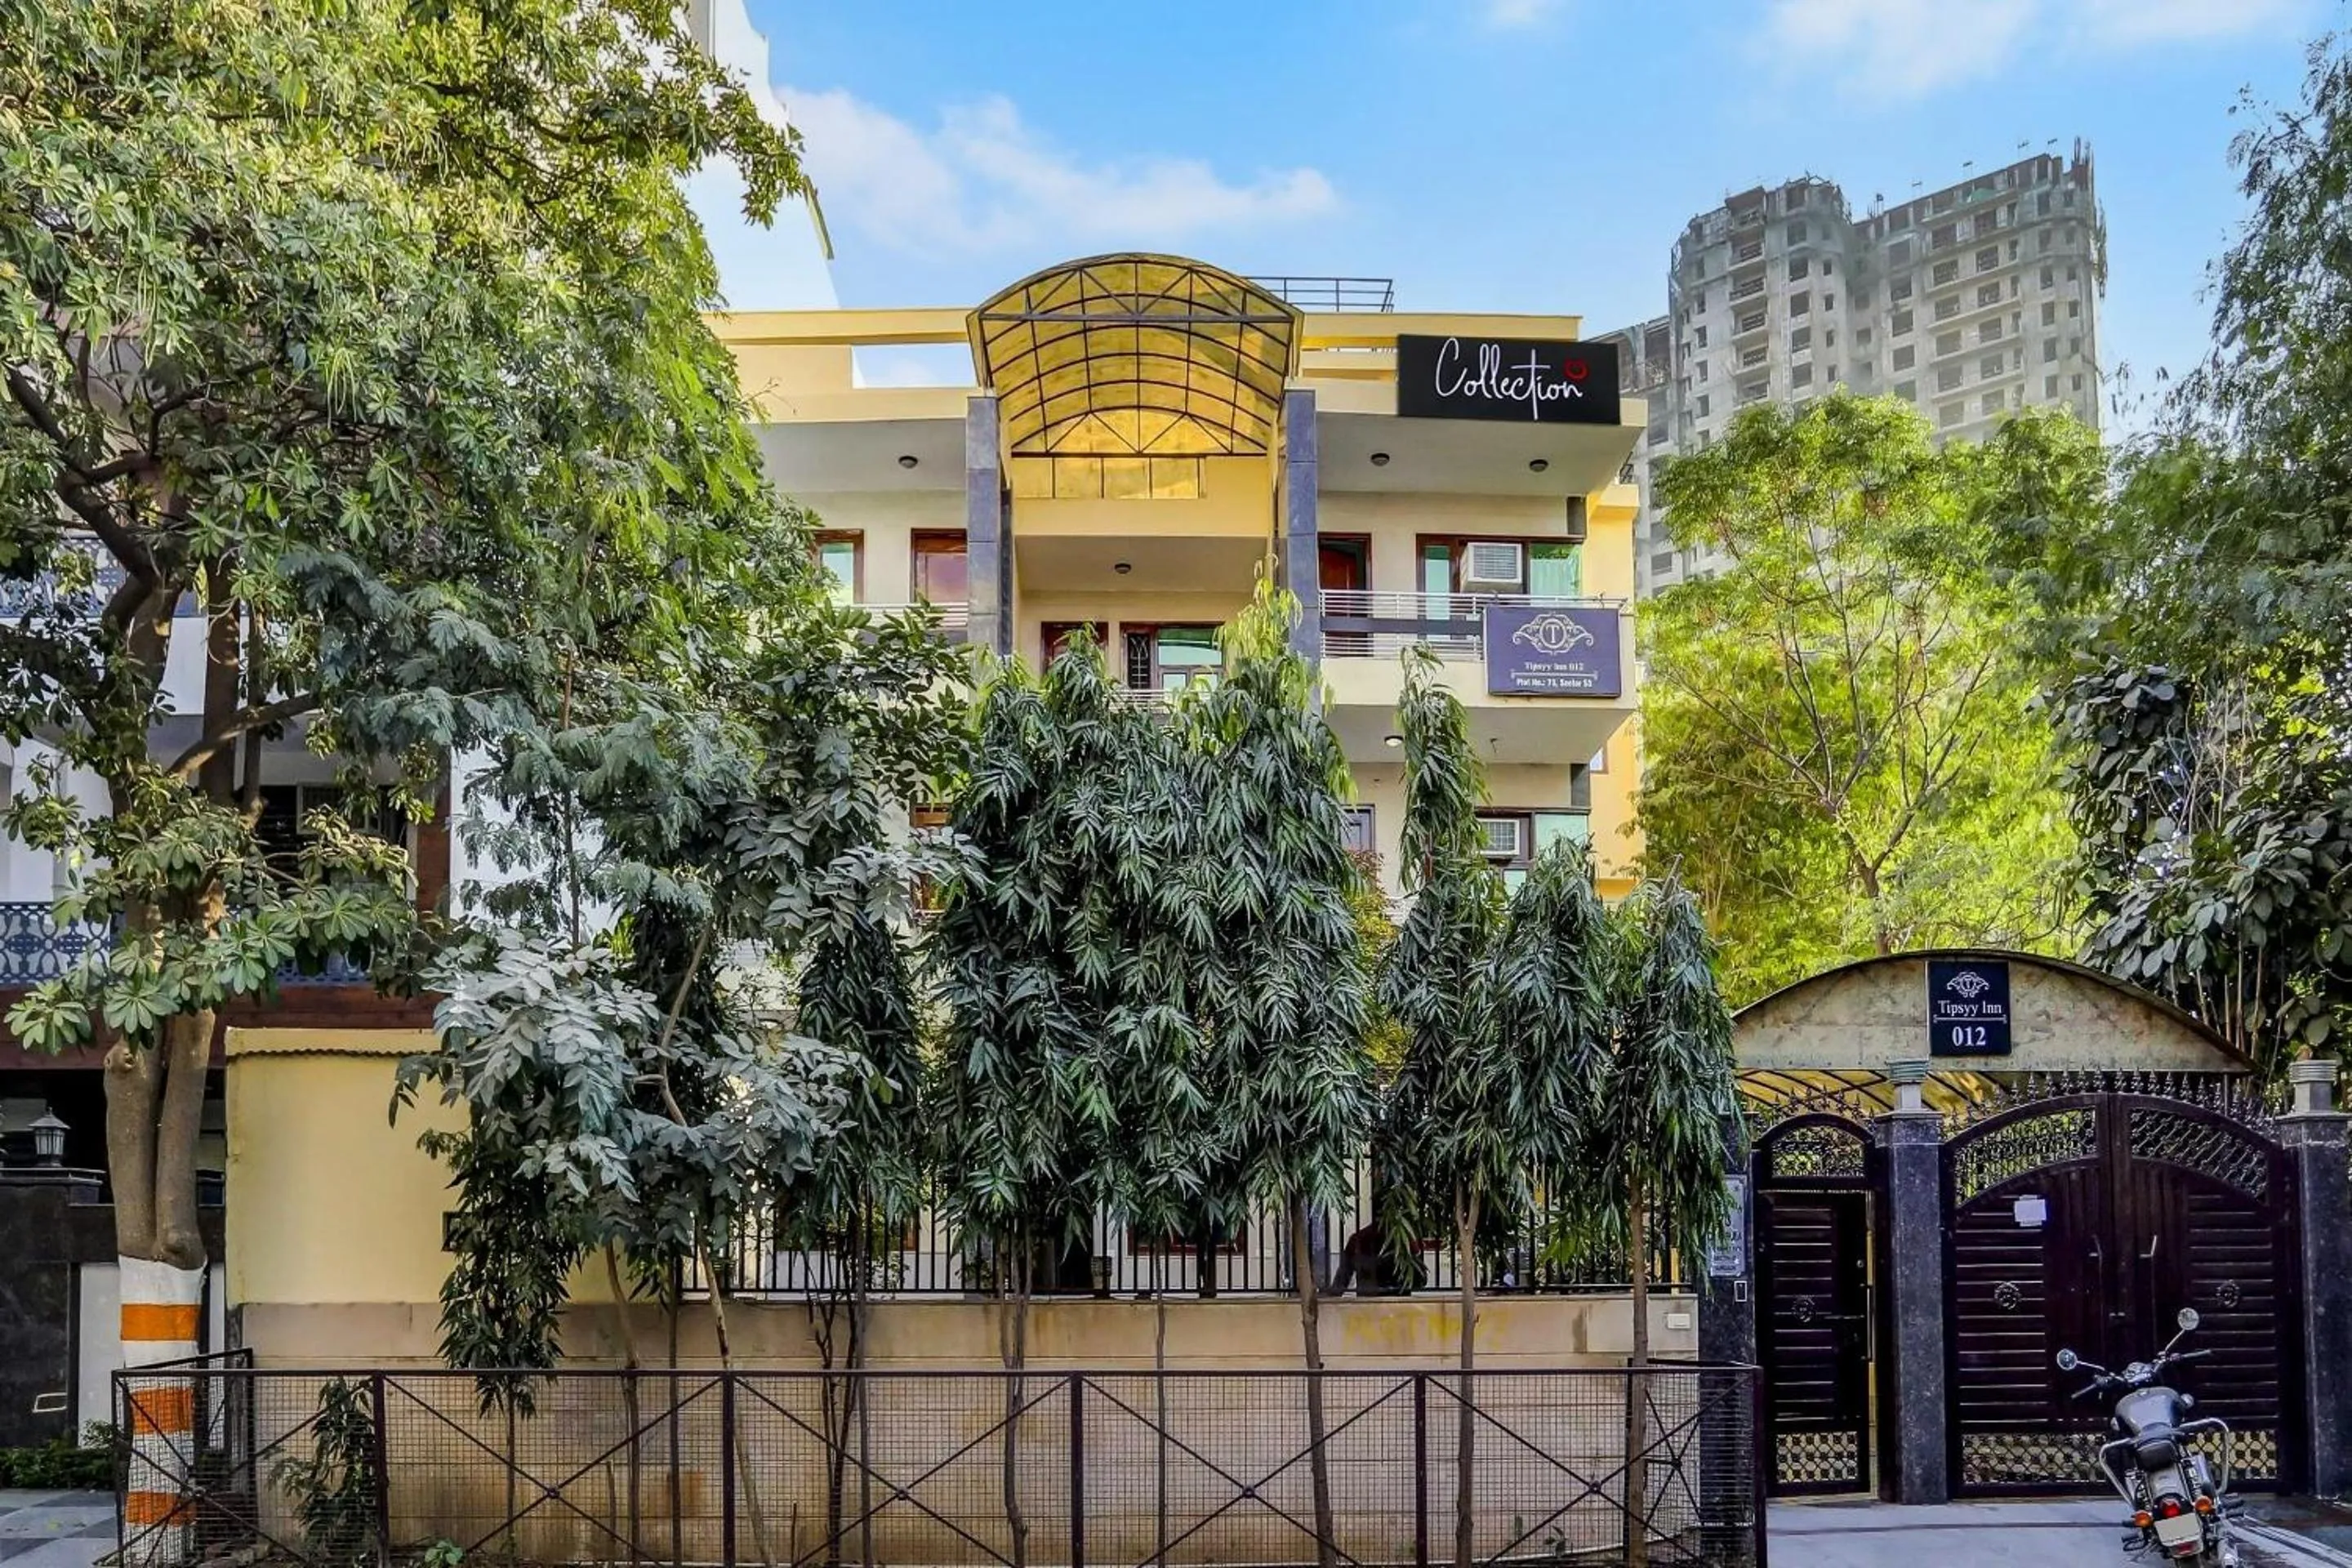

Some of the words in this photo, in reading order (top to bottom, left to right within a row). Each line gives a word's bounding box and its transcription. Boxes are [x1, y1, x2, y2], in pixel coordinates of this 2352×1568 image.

[1435, 337, 1584, 421] Collection
[1545, 624, 1560, 644] T
[1937, 1000, 1979, 1017] Tipsyy
[1982, 1000, 2002, 1013] Inn
[1952, 1026, 1986, 1046] 012
